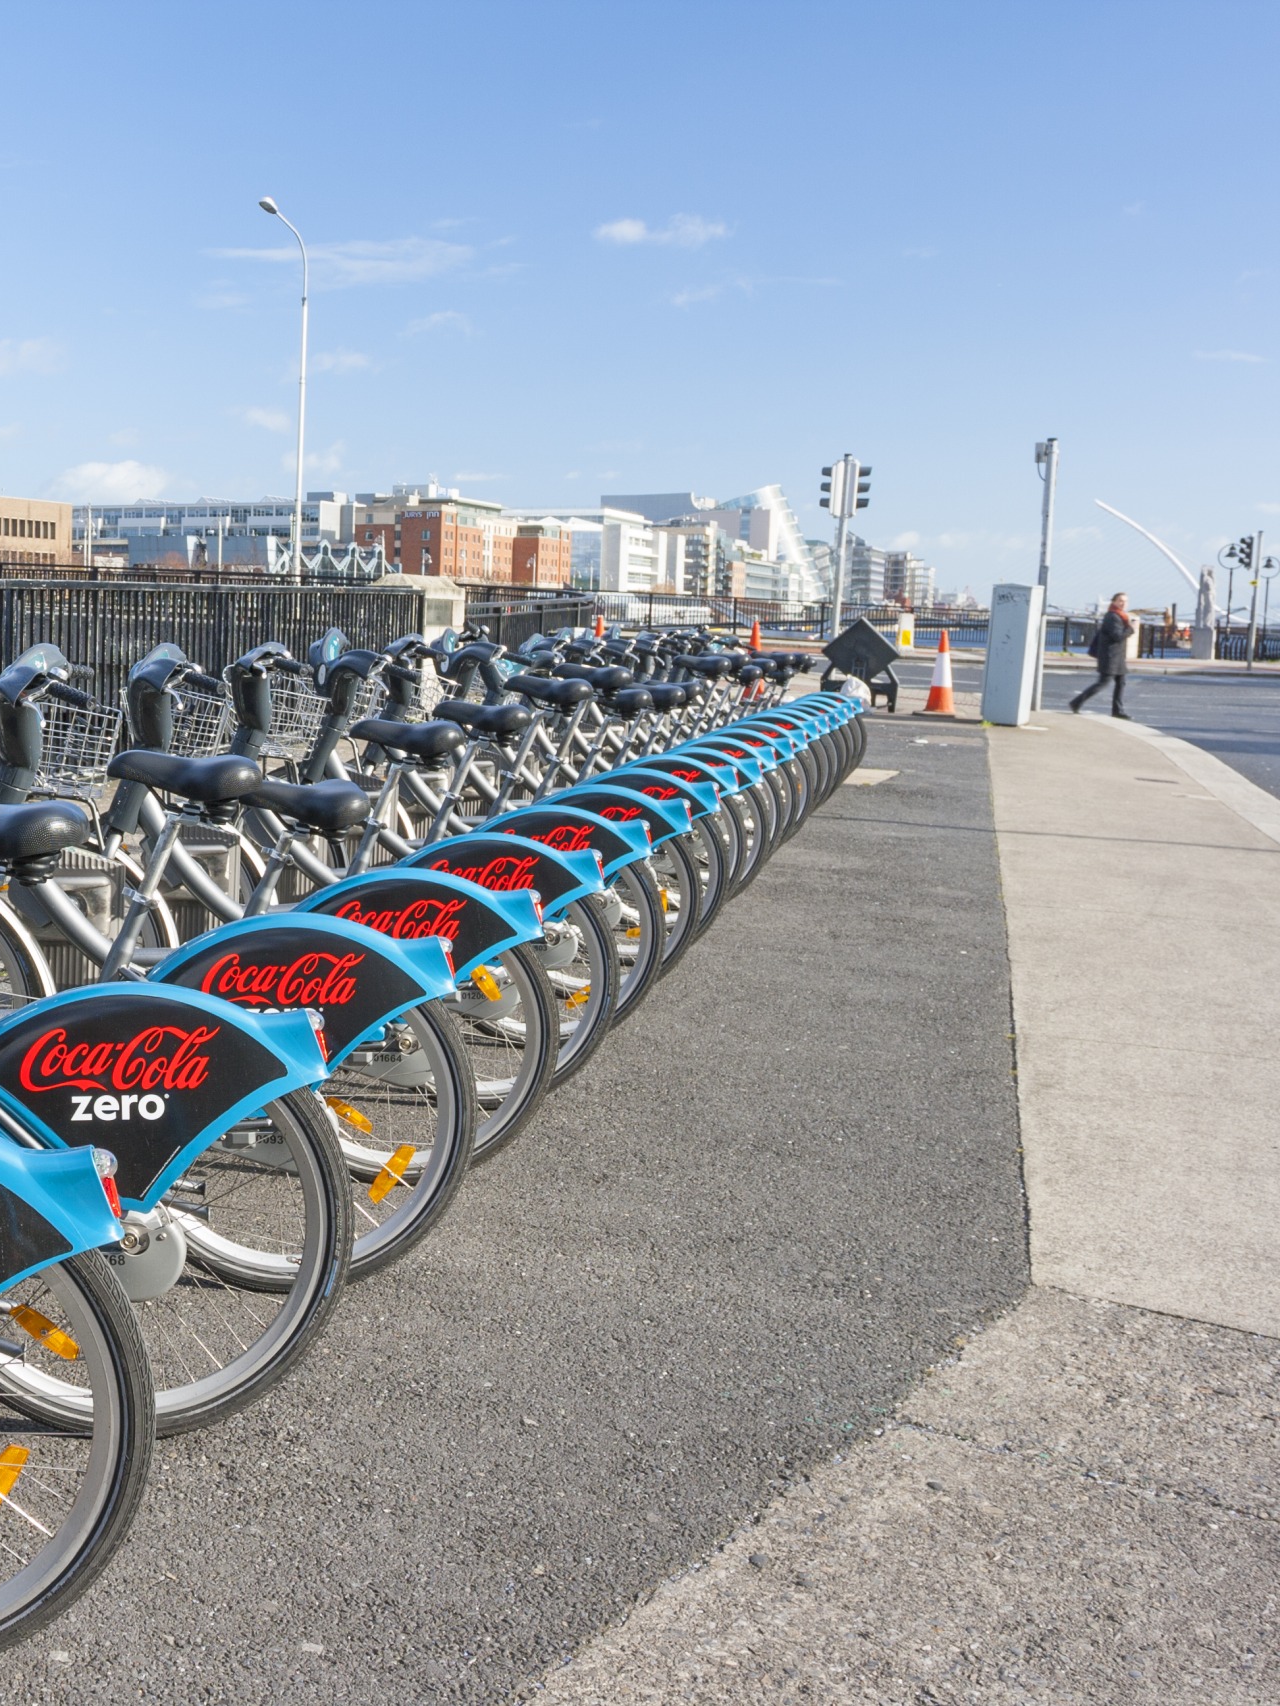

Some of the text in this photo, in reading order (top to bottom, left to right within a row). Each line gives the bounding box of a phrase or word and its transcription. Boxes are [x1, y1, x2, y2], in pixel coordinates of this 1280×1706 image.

[201, 953, 366, 1005] Coca-Cola
[20, 1026, 220, 1091] Coca-Cola
[71, 1093, 165, 1121] zero
[256, 1134, 284, 1145] 0093
